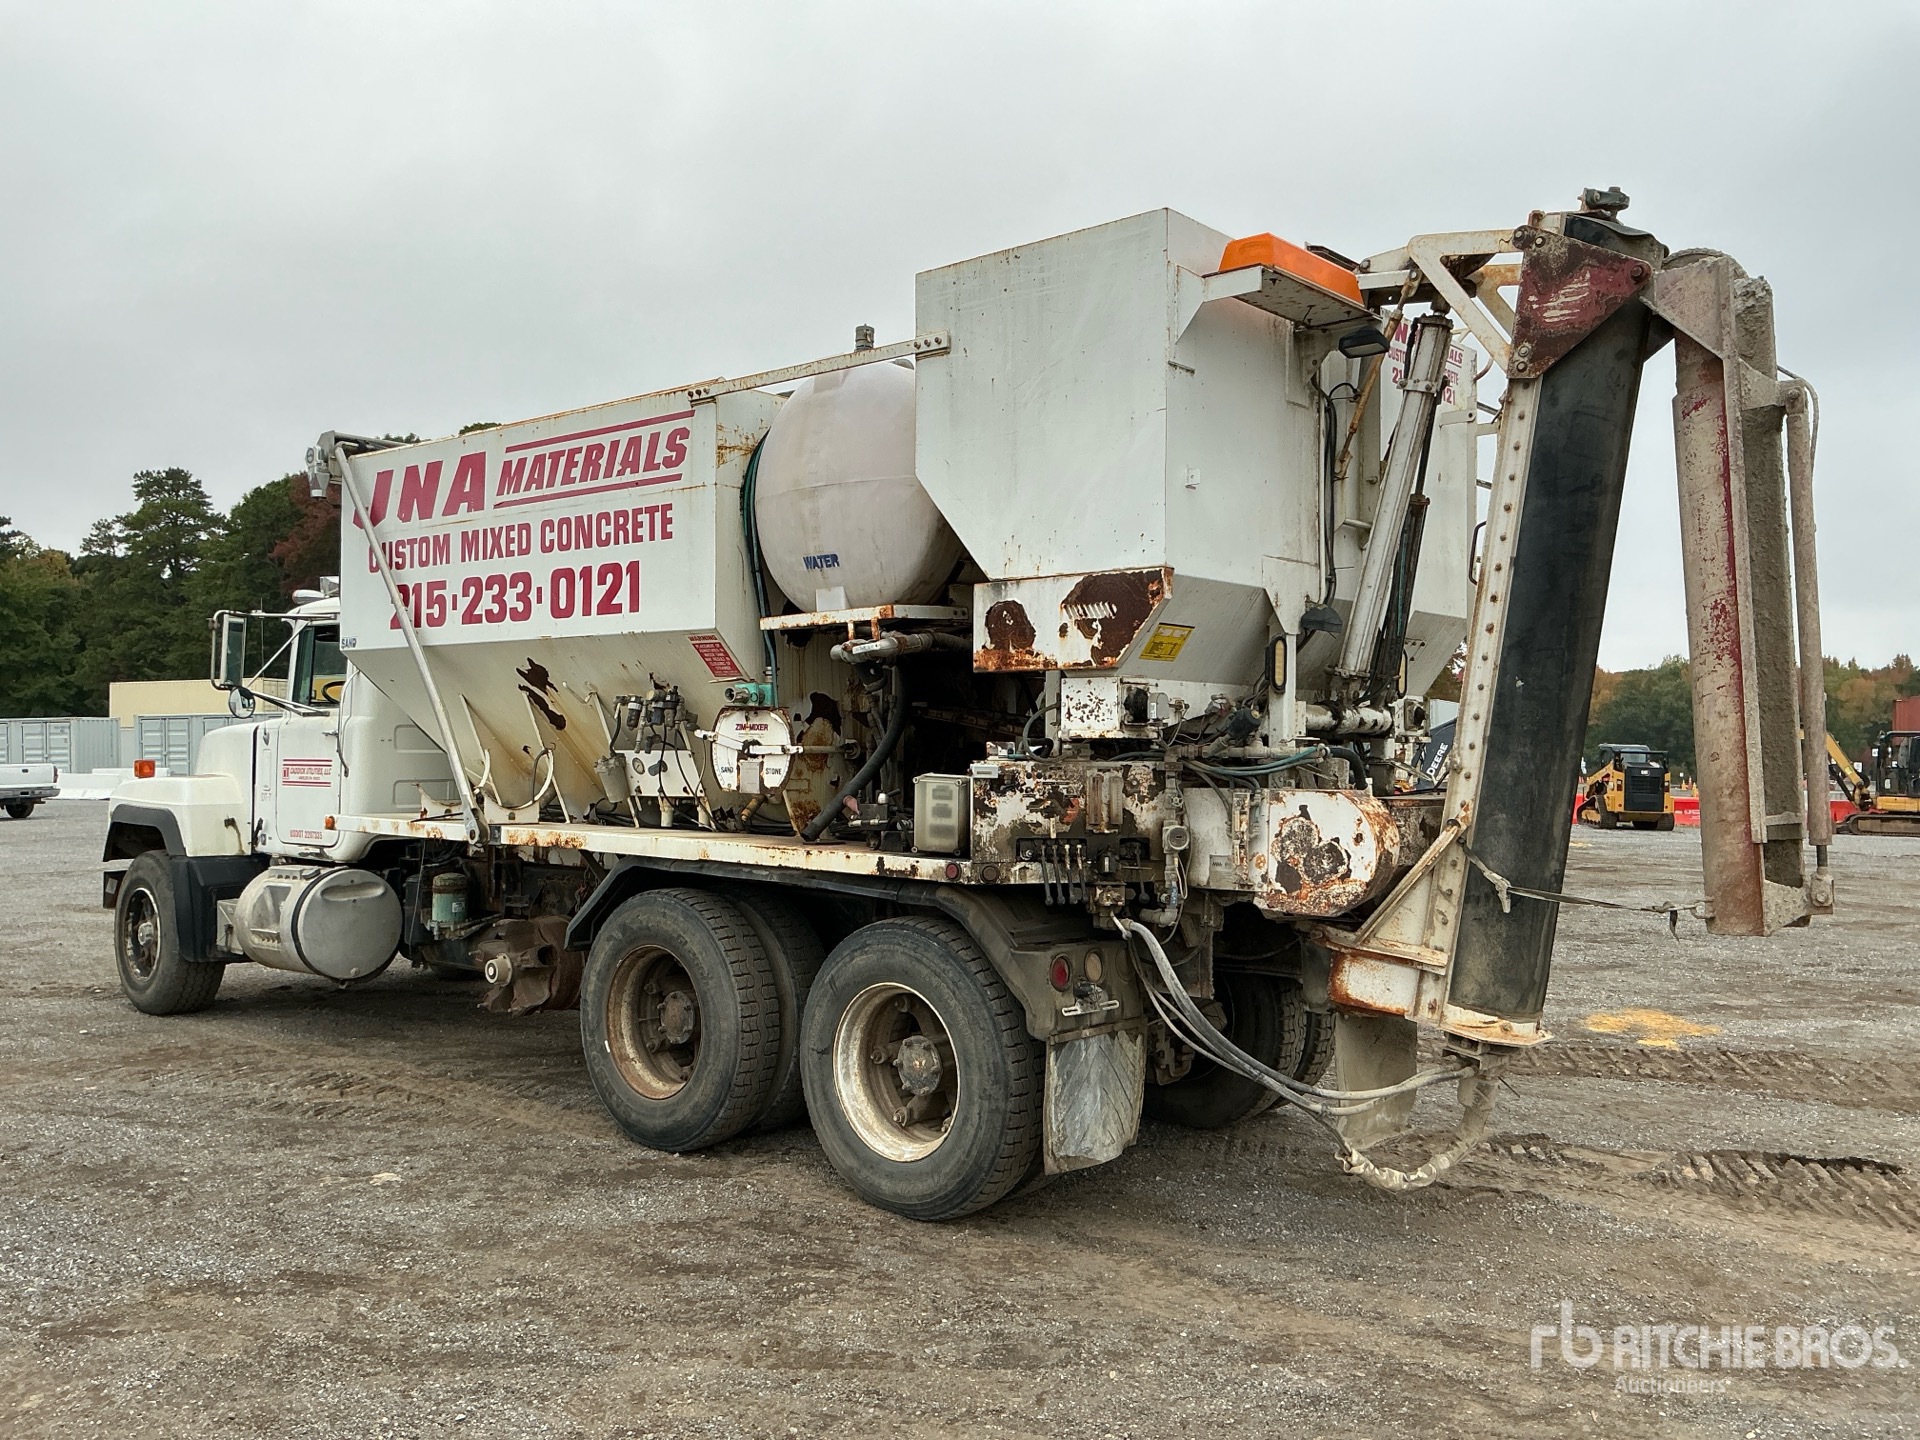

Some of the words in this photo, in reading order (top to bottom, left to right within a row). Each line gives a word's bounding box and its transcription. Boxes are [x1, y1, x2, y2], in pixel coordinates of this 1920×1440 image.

[353, 451, 487, 530] JNA
[495, 426, 691, 497] MATERIALS
[368, 532, 451, 574] CUSTOM
[460, 521, 532, 563] MIXED
[539, 502, 674, 554] CONCRETE
[802, 553, 841, 571] WATER
[721, 766, 734, 774] SAND
[765, 767, 782, 775] STONE
[1426, 742, 1449, 776] DEERE
